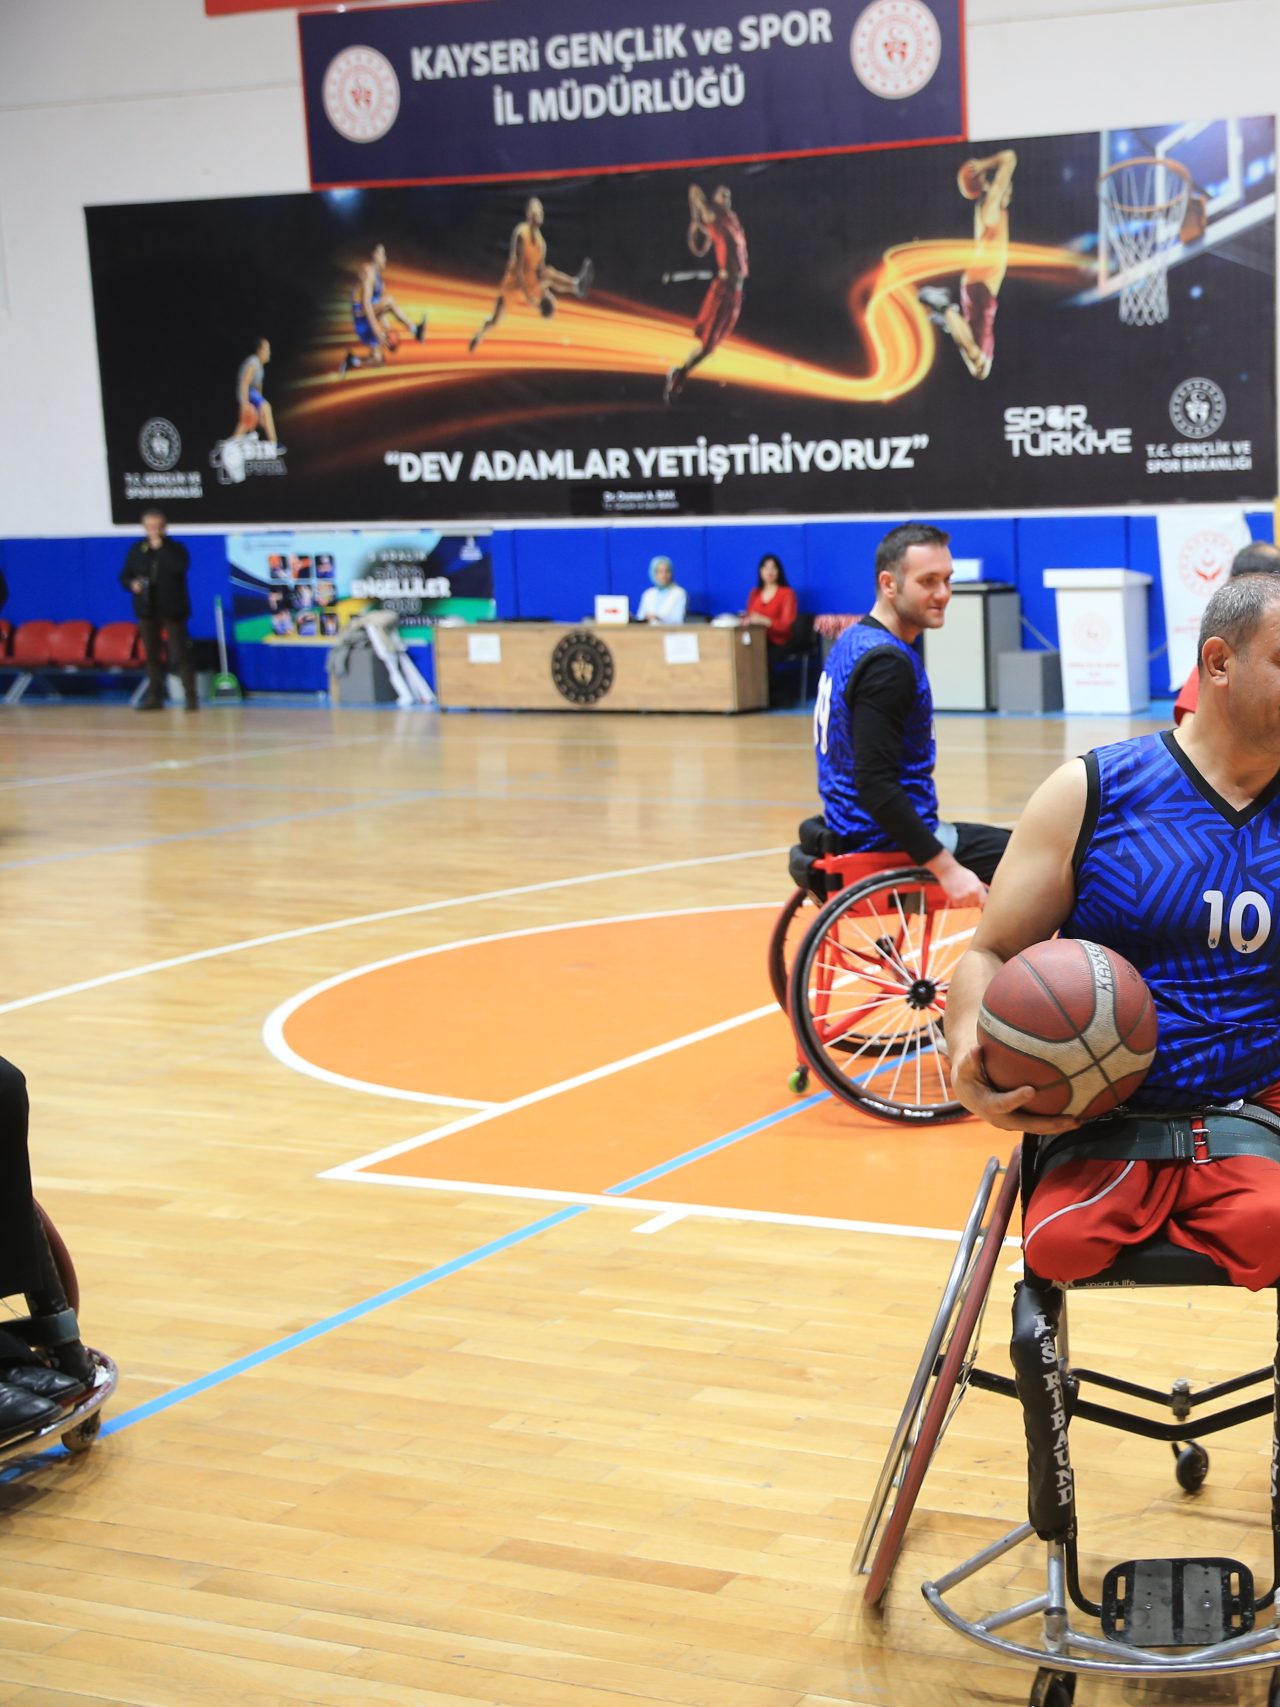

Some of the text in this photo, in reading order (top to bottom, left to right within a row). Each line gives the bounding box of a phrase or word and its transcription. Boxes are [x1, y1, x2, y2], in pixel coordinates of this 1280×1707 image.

[692, 26, 733, 56] ve
[738, 7, 833, 52] SPOR
[493, 62, 746, 126] İL MÜDÜRLÜĞÜ
[1004, 426, 1133, 457] TÜRKİYE
[1231, 440, 1252, 456] VE
[470, 448, 631, 482] ADAMLAR
[1145, 458, 1180, 474] SPOR
[1202, 890, 1272, 954] 10
